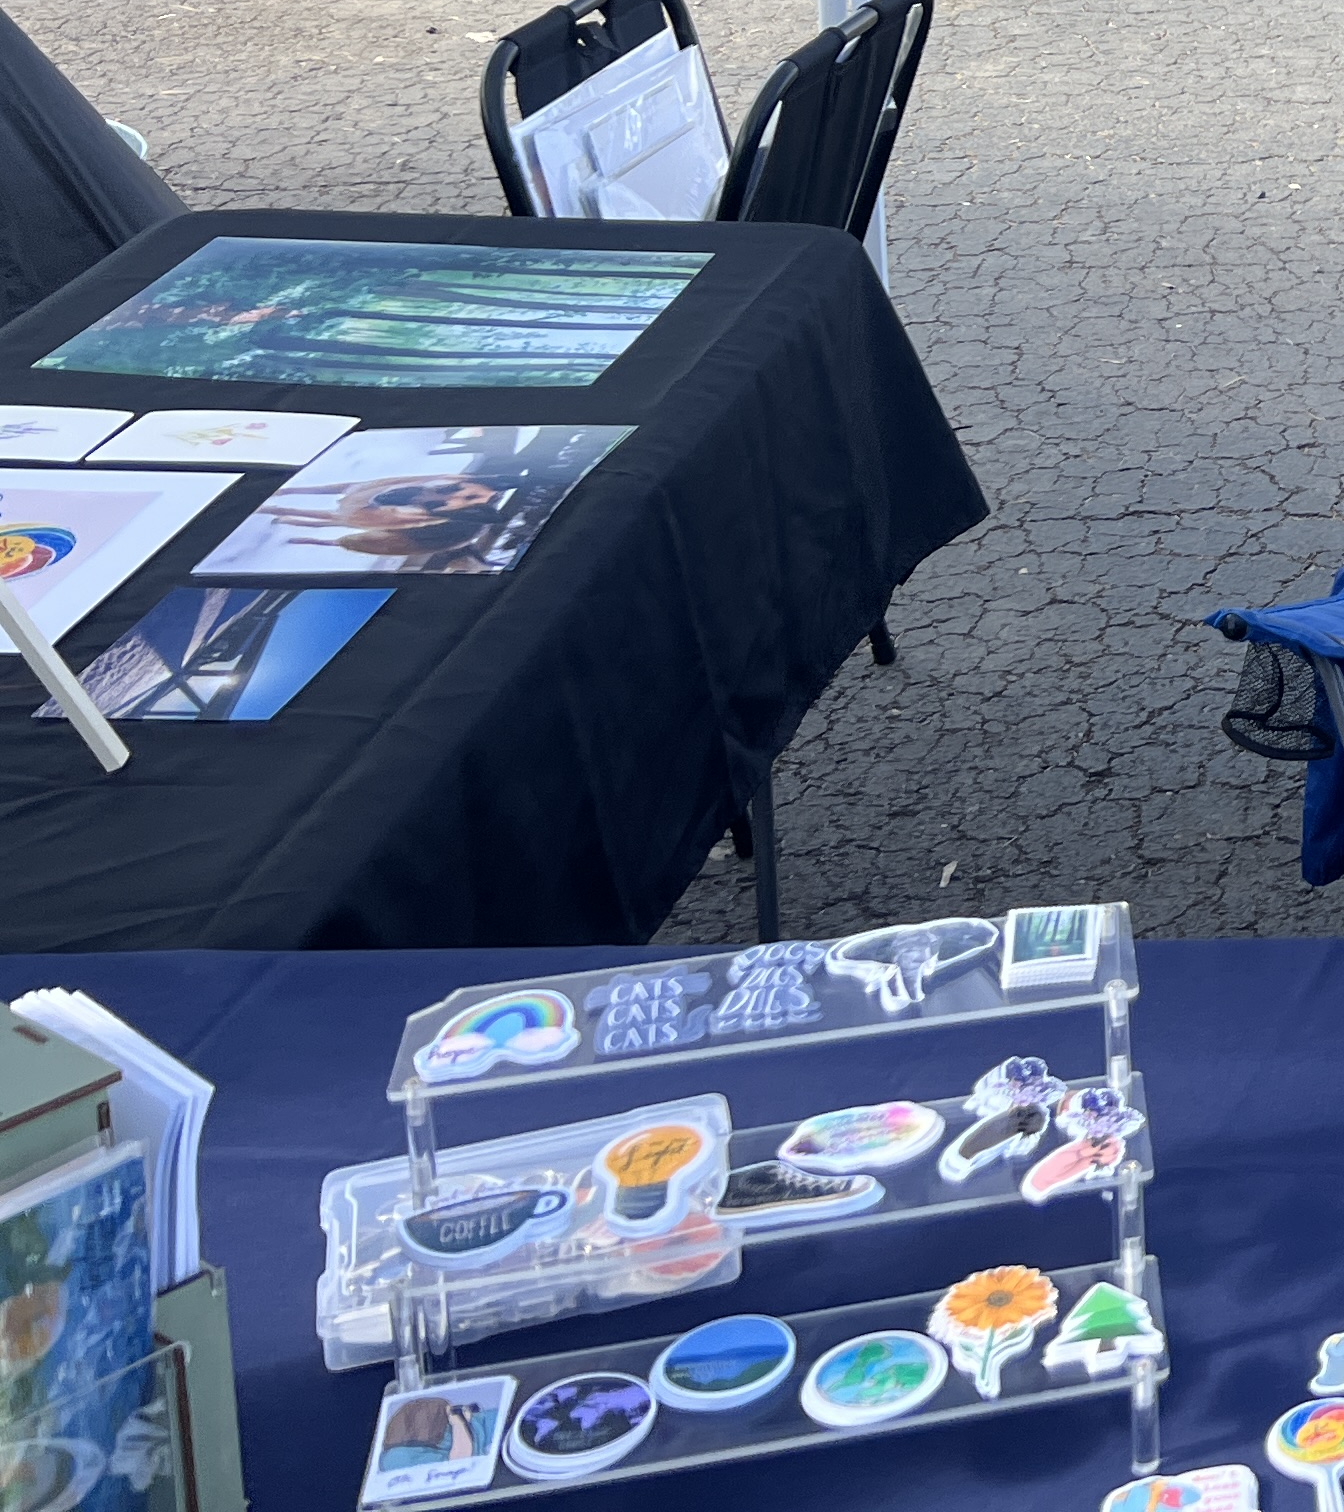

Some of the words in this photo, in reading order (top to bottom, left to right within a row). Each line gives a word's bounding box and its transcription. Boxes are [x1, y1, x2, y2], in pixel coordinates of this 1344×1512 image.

[735, 941, 826, 968] DOGS
[610, 976, 684, 1005] CATS
[607, 996, 681, 1027] CATS
[603, 1021, 679, 1054] CATS
